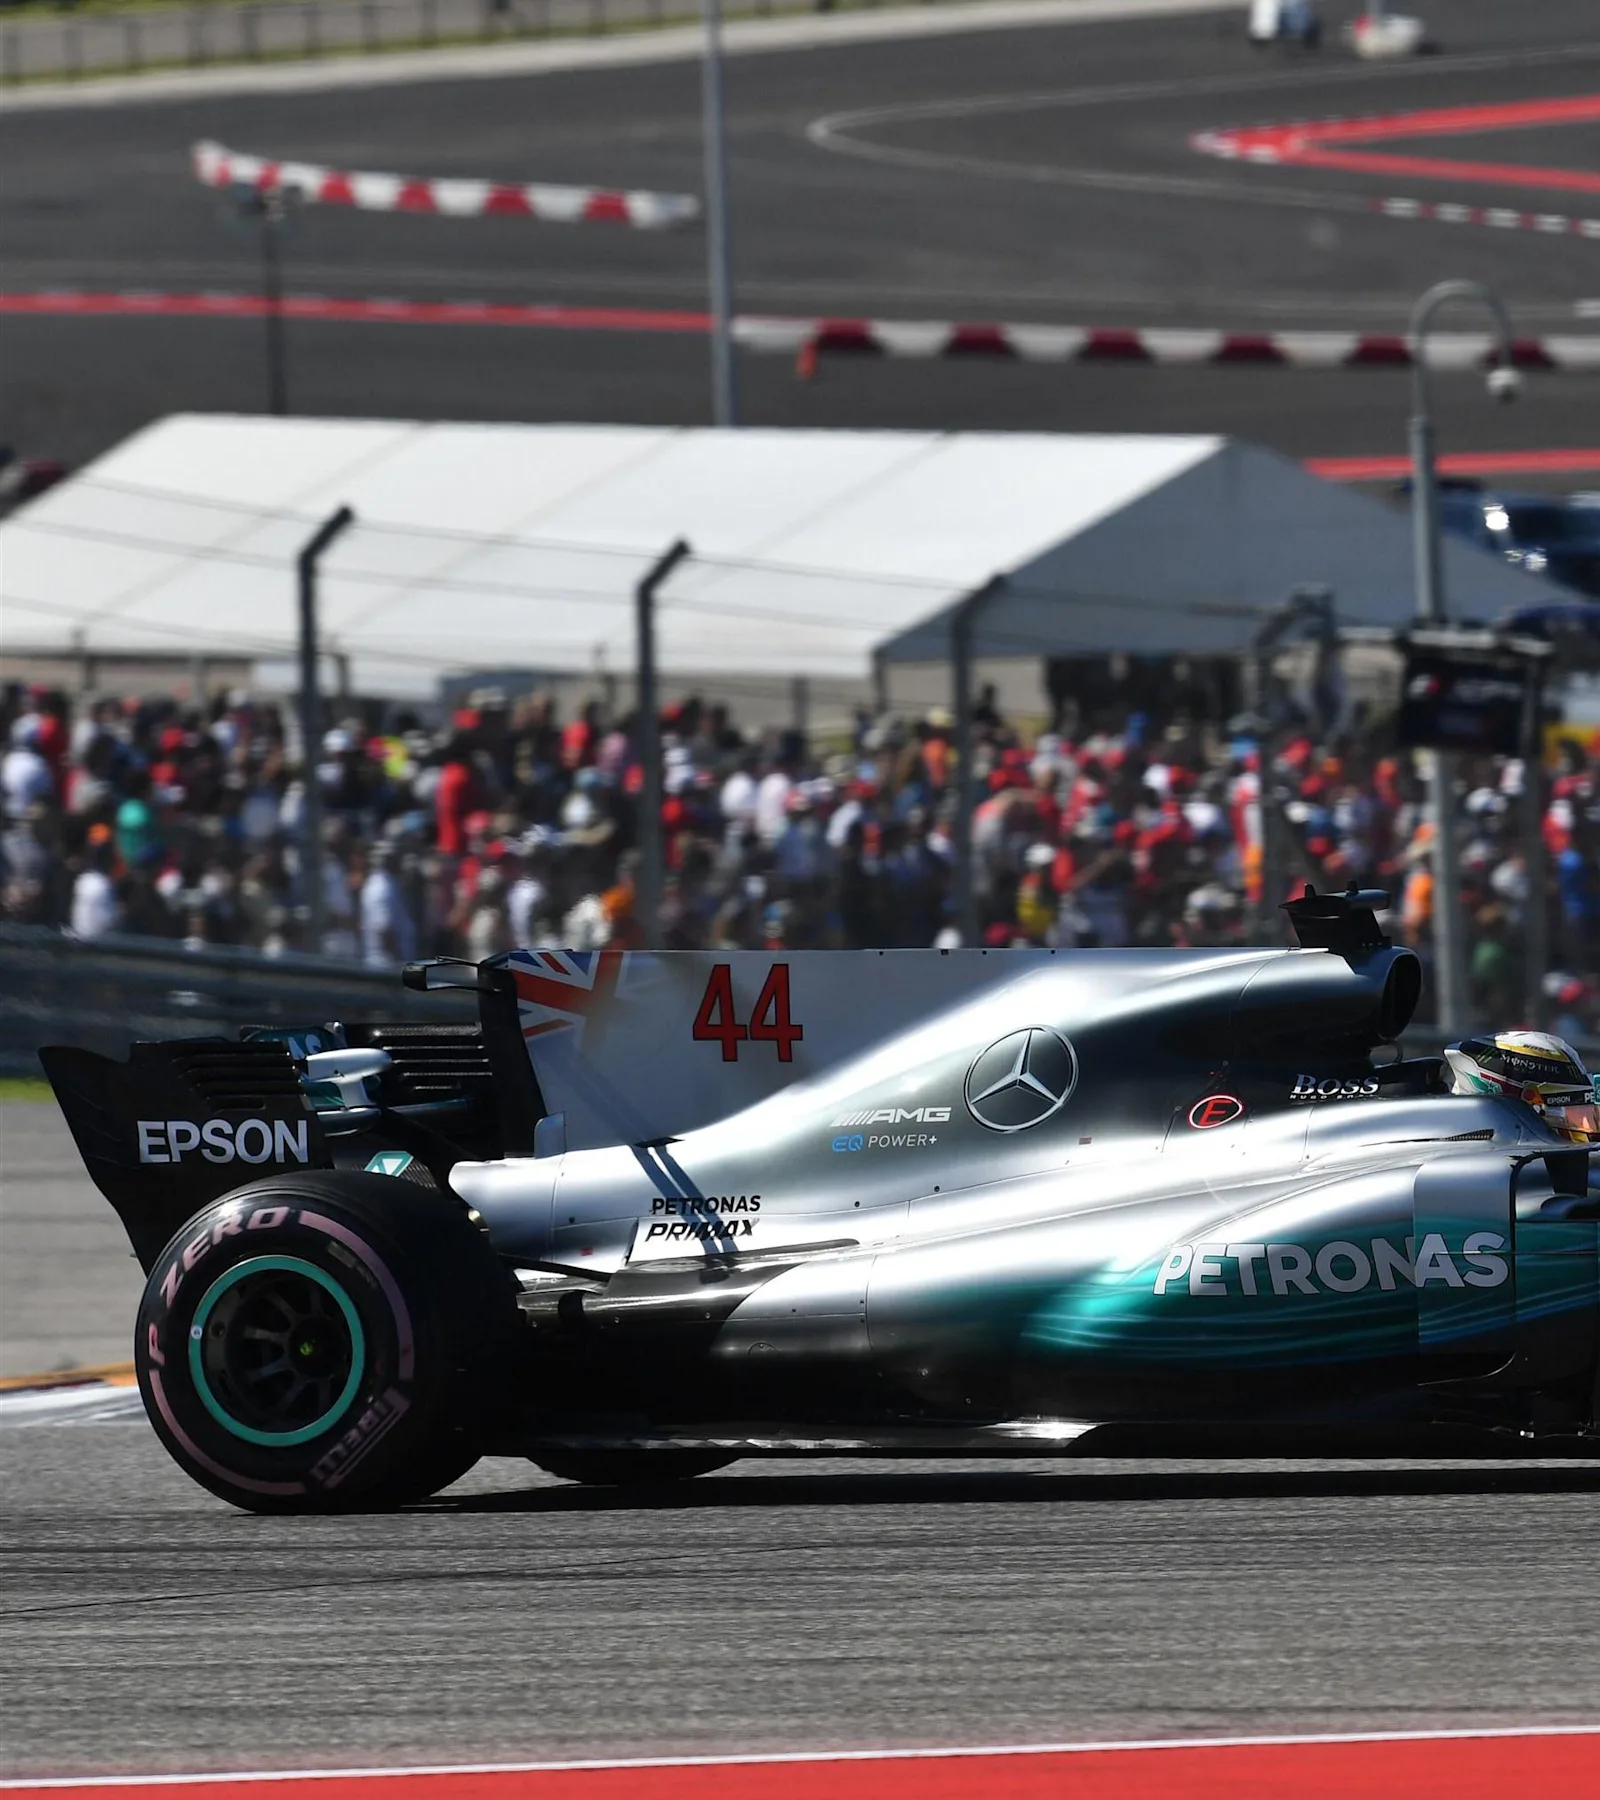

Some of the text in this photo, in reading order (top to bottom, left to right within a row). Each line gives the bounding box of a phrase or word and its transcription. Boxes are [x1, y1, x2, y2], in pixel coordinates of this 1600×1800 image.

[693, 963, 803, 1062] 44
[1291, 1073, 1379, 1095] BOSS
[1547, 1092, 1595, 1104] EPSON PE
[864, 1106, 952, 1124] AMG
[136, 1118, 309, 1164] EPSON
[831, 1133, 938, 1153] EQ POWER+
[651, 1195, 761, 1215] PETRONAS
[645, 1218, 760, 1242] PRIMAX
[1153, 1231, 1510, 1296] PETRONAS
[149, 1206, 291, 1366] P ZERO
